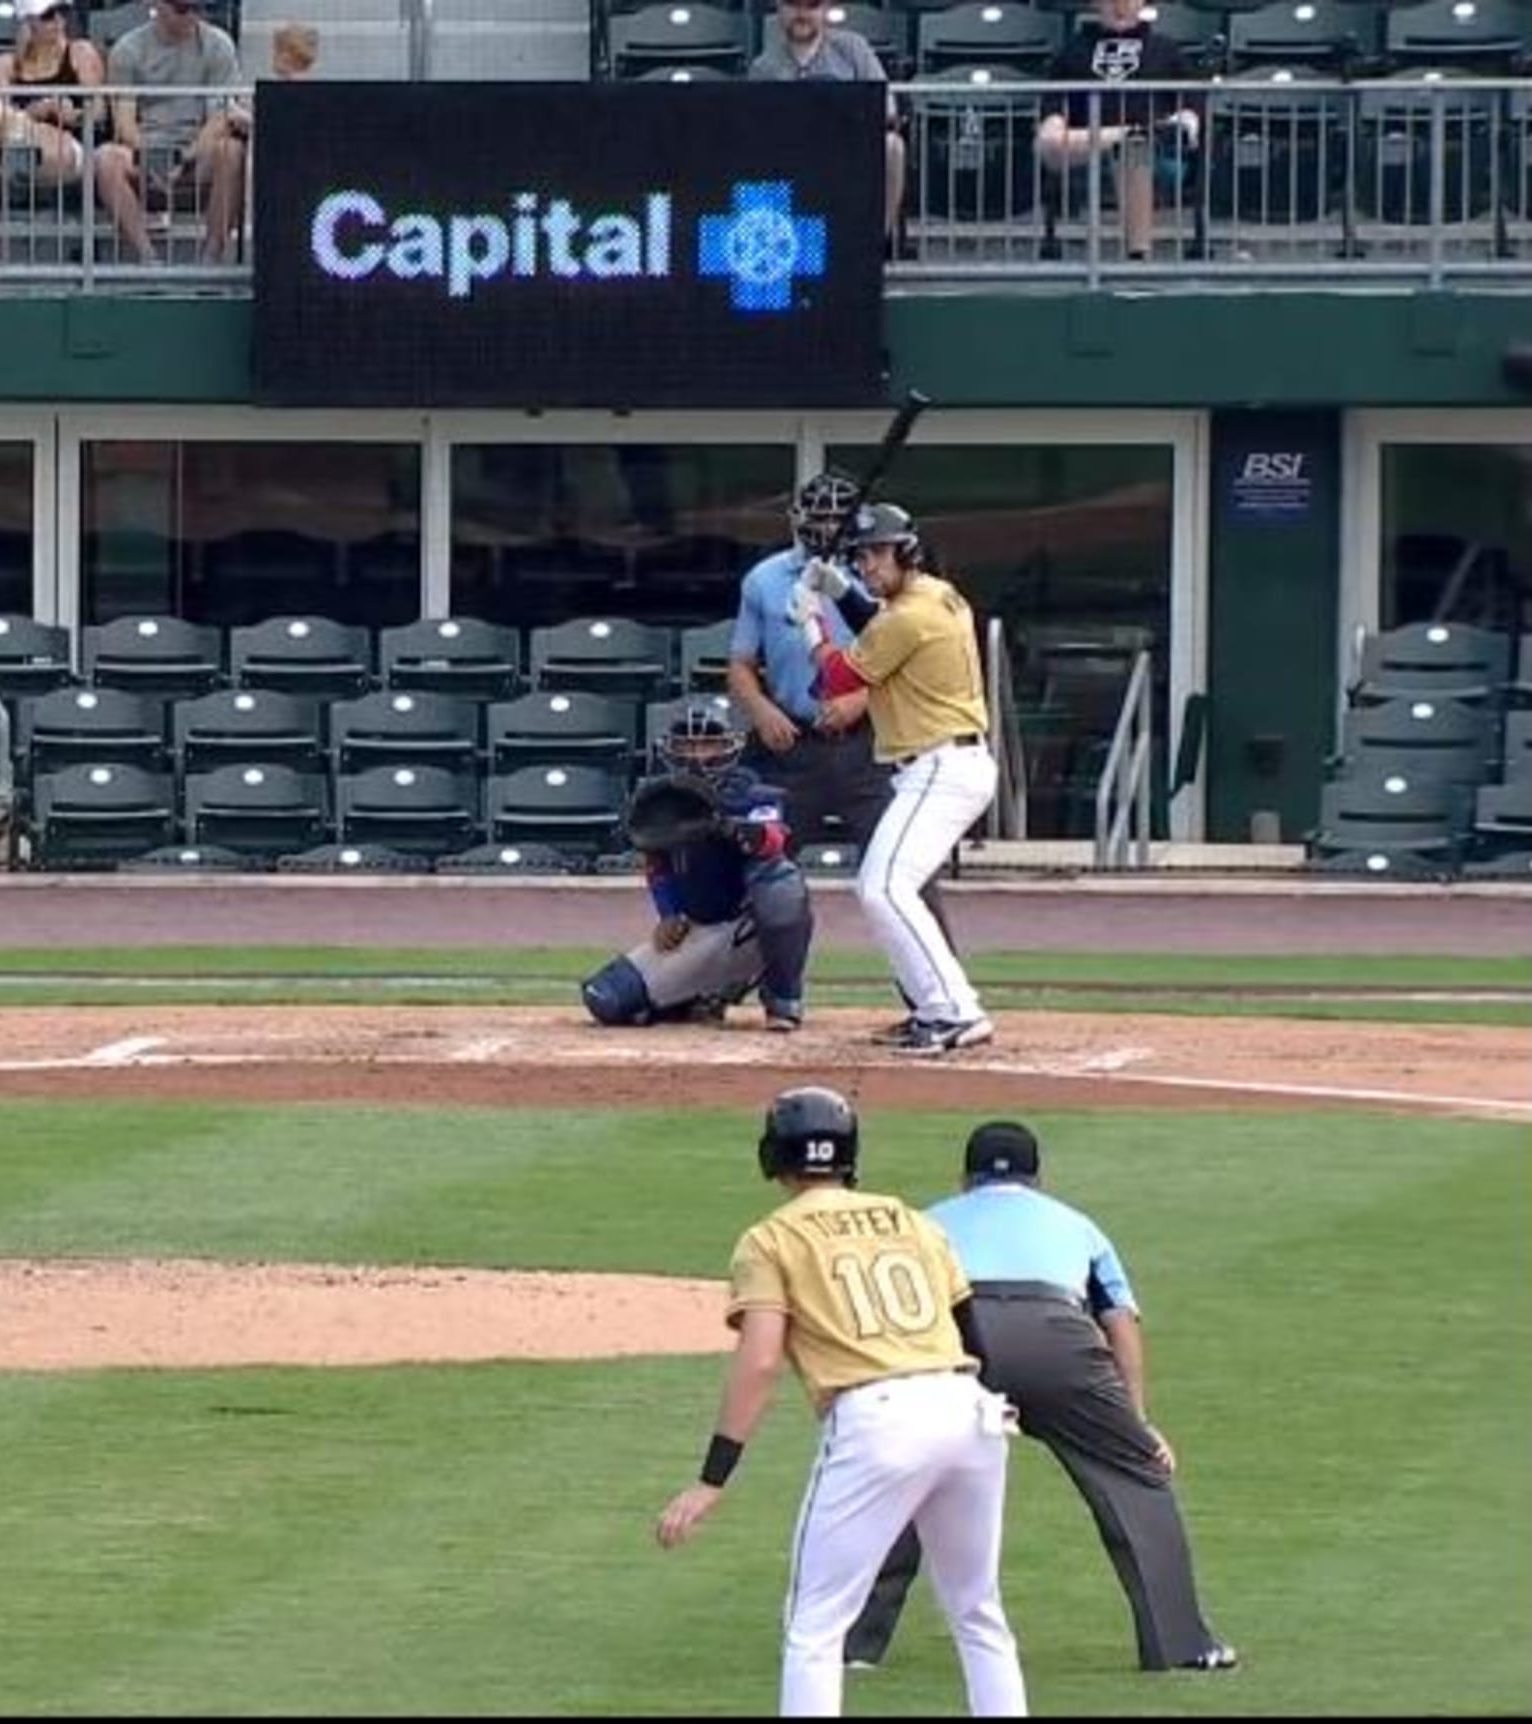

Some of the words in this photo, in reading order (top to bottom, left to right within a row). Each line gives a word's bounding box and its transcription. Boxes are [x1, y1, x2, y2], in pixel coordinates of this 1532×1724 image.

[310, 188, 673, 298] Capital
[1242, 452, 1303, 479] BSI
[805, 1139, 835, 1162] 10
[831, 1248, 938, 1341] 10
